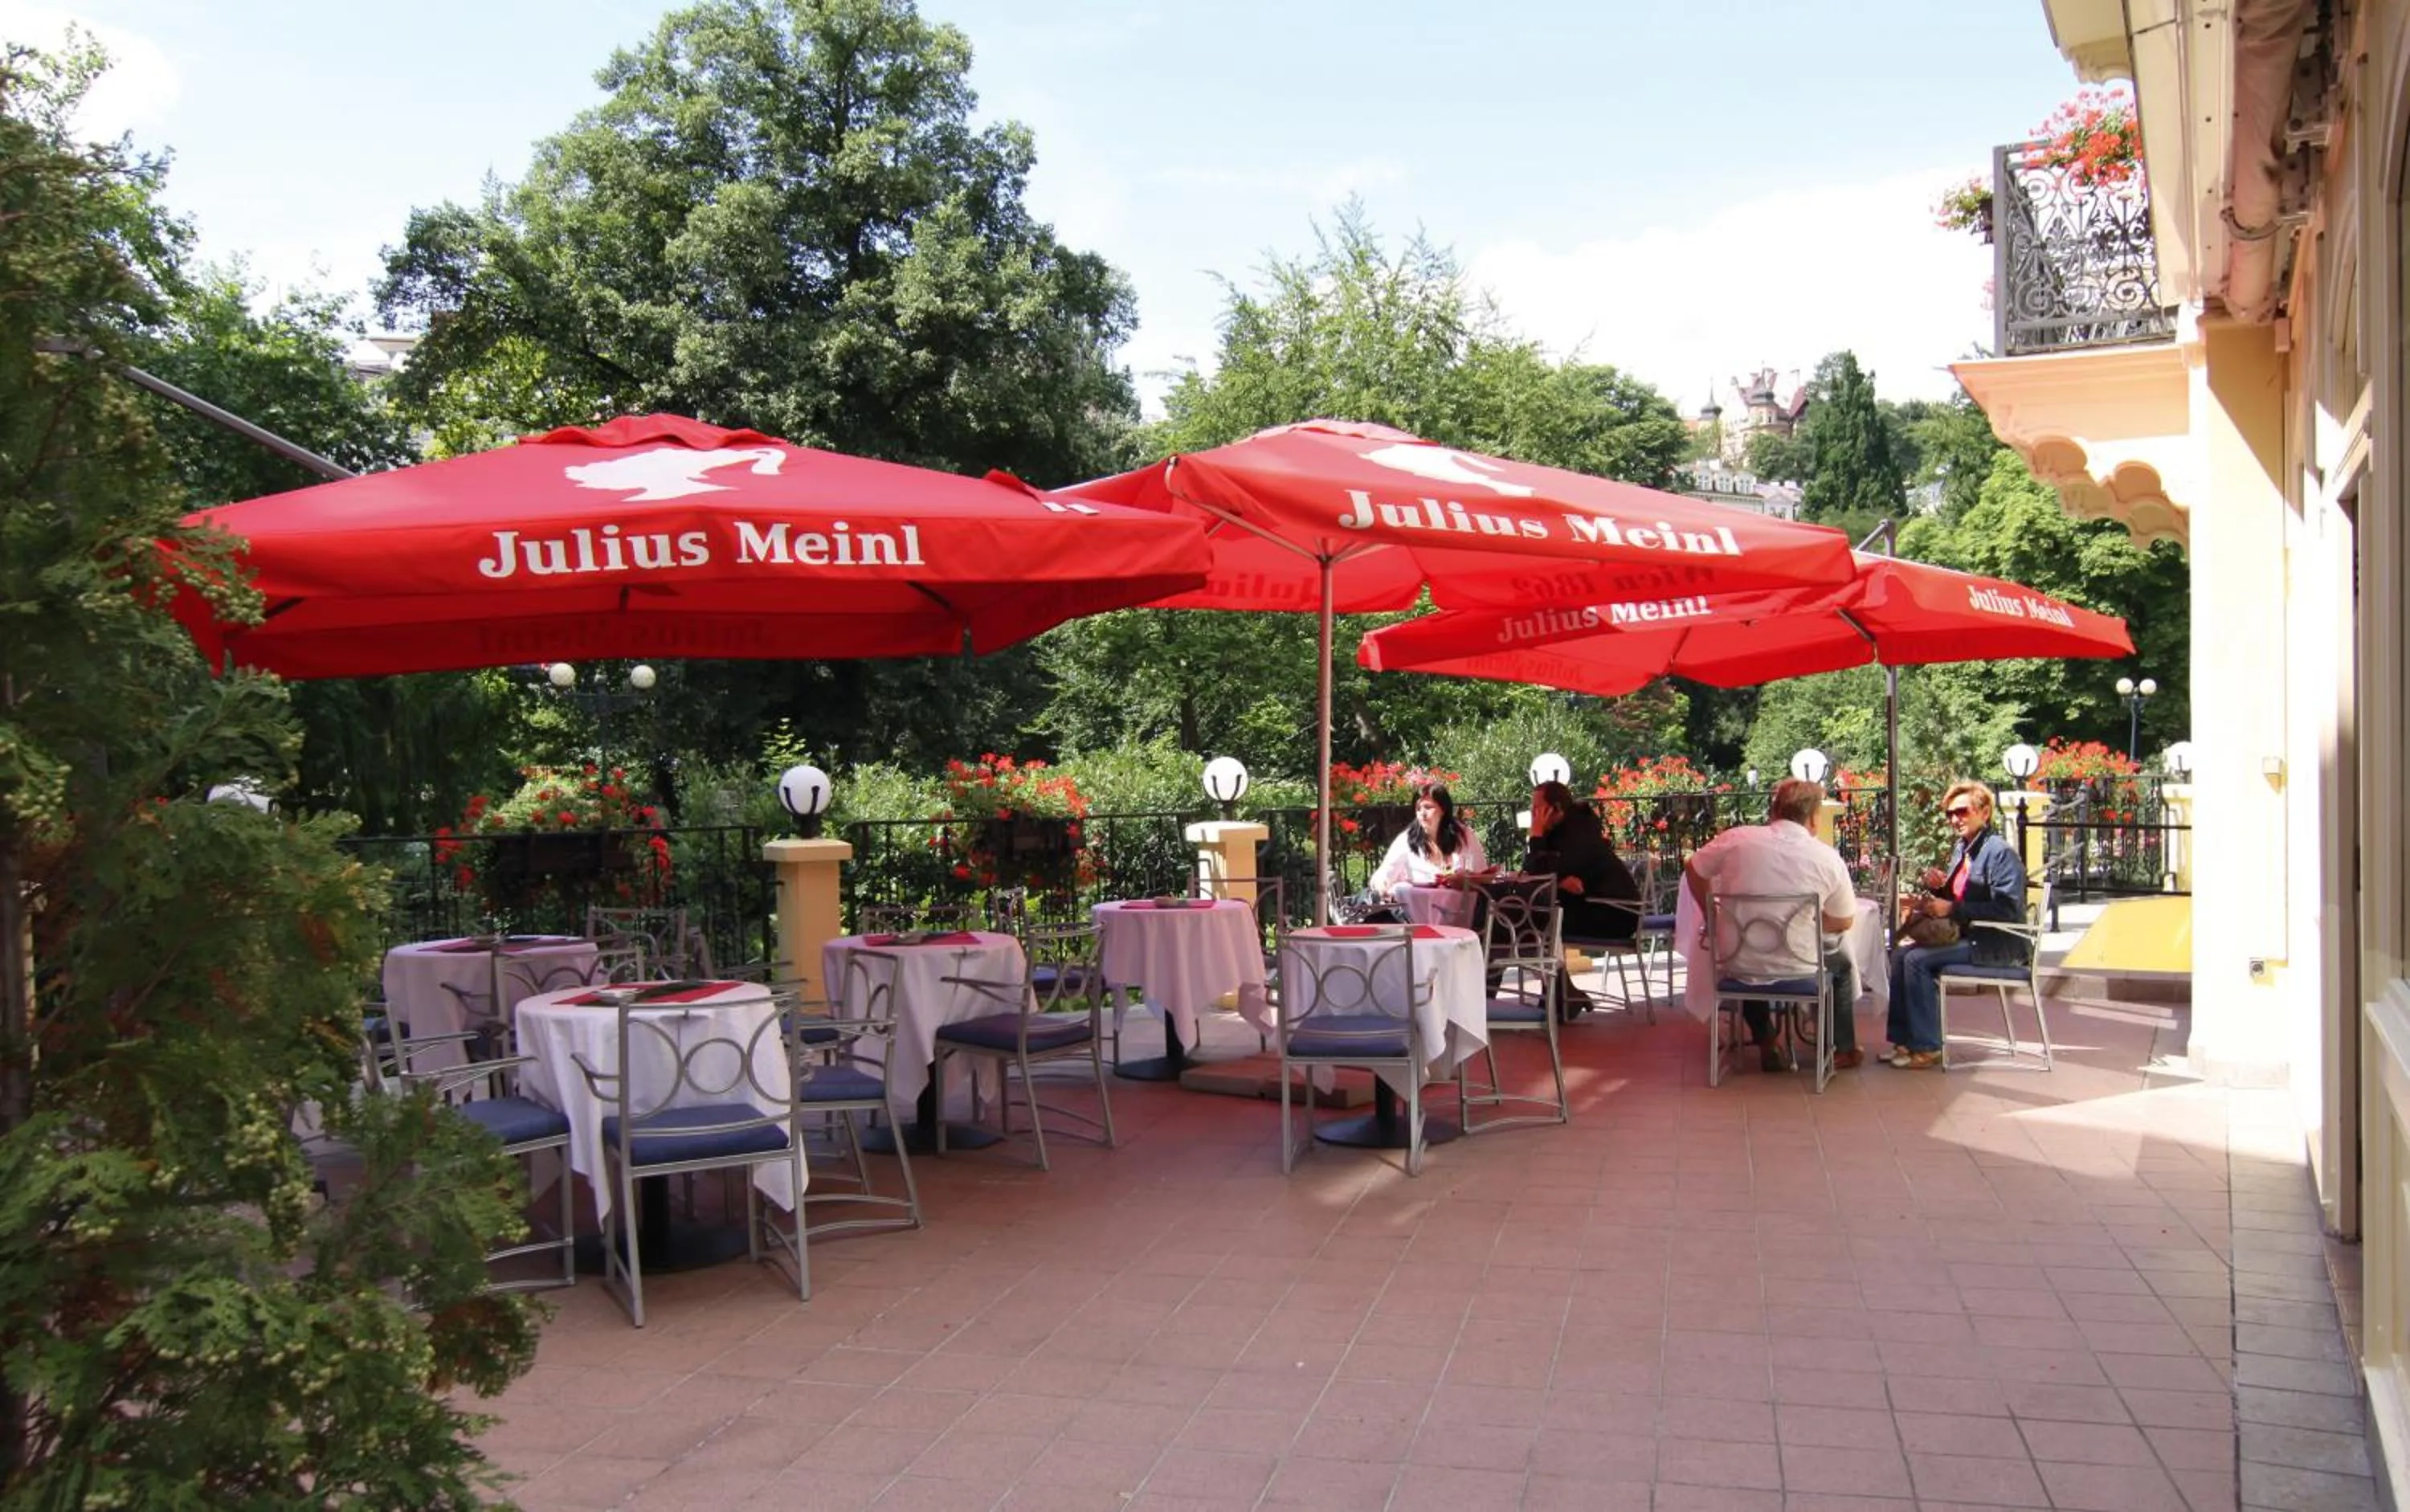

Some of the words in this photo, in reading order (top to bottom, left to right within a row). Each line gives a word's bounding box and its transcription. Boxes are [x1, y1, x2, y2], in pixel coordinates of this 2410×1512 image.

[1338, 488, 1549, 539] Julius
[1562, 513, 1744, 557] Meinl
[477, 524, 710, 578] Julius
[733, 521, 926, 566] Meinl
[1497, 604, 1601, 643] Julius
[1609, 594, 1714, 625] Meinl
[1967, 584, 2024, 619] Julius
[2023, 595, 2076, 628] Meinl
